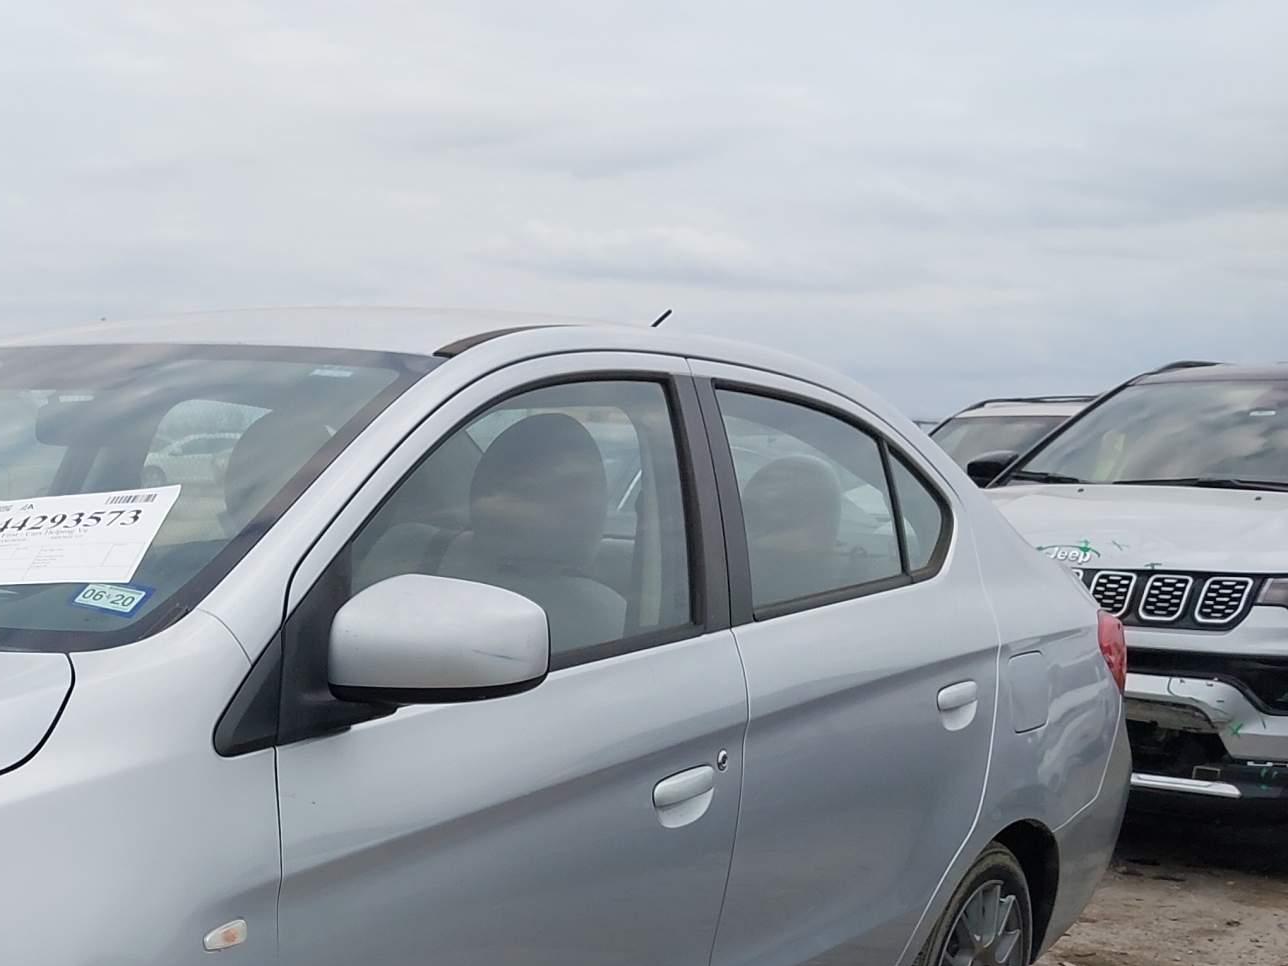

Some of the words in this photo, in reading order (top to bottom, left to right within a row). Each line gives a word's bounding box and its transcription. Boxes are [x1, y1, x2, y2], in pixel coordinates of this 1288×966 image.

[1046, 547, 1092, 566] Jeep
[82, 589, 107, 601] 06
[110, 593, 135, 607] 20
